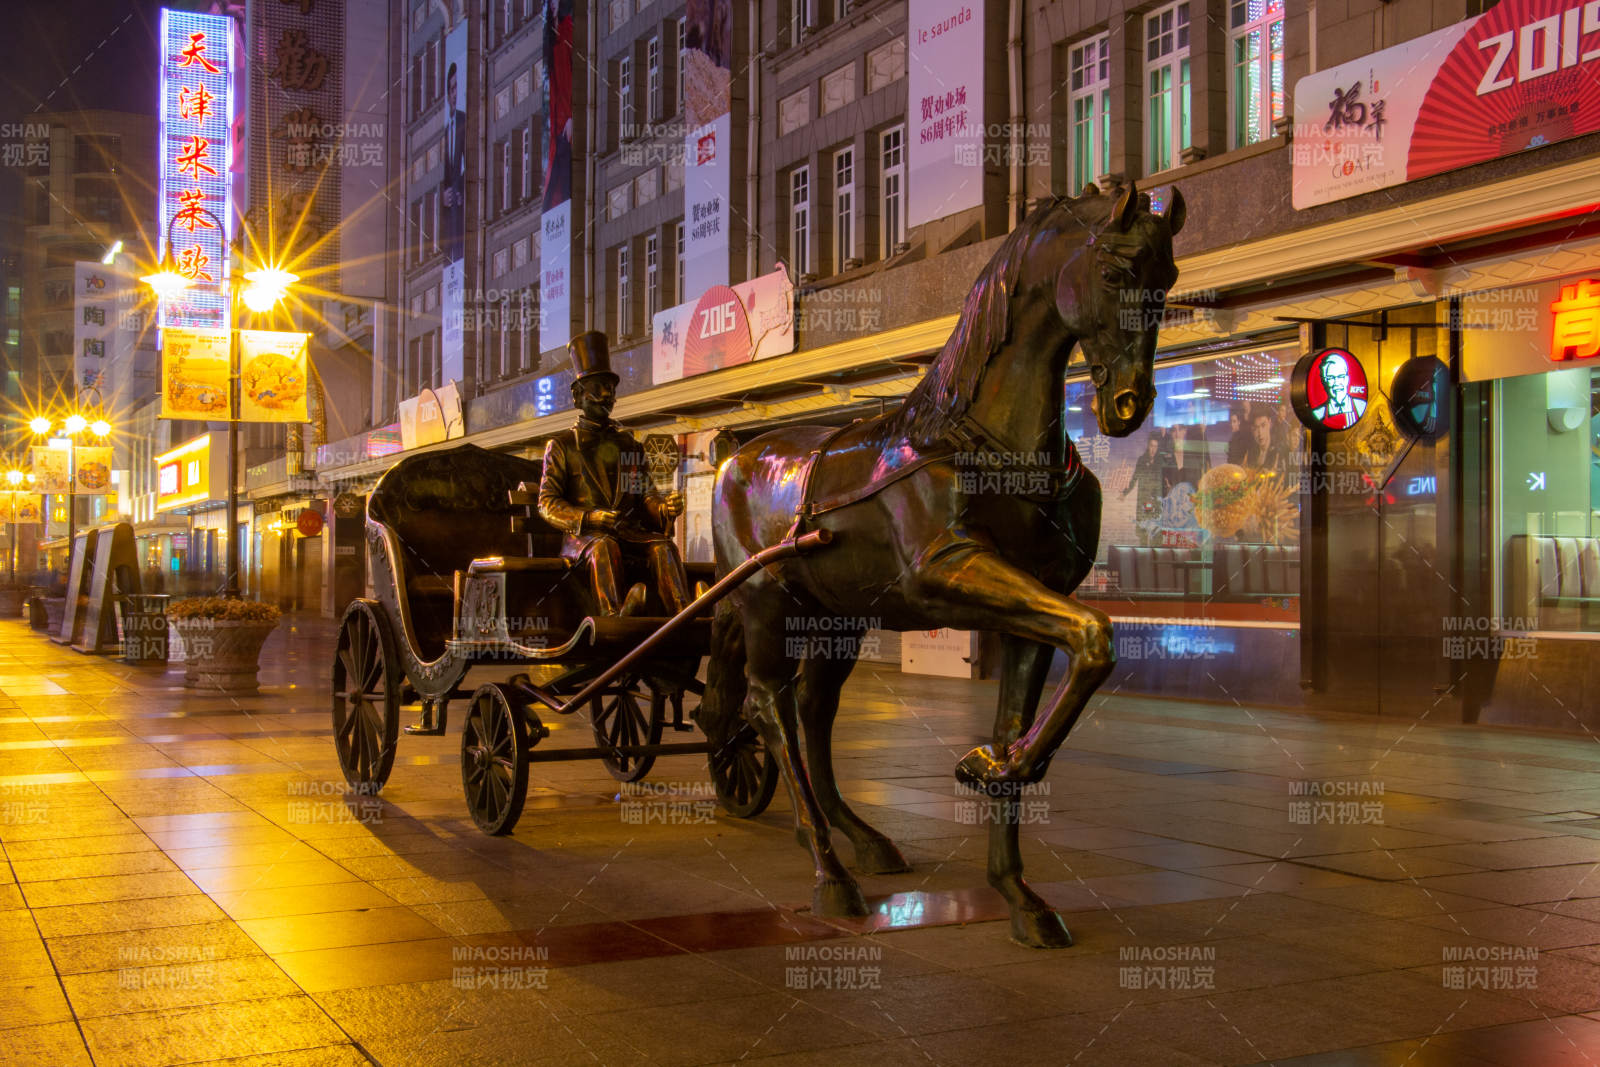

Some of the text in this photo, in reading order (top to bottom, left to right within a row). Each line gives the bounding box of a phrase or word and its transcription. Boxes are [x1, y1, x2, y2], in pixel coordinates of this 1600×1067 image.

[918, 7, 972, 45] le saunda
[921, 86, 967, 125] 贺劝业场
[920, 110, 968, 145] 86周年庆
[700, 301, 737, 340] 2015
[1350, 385, 1366, 395] KFC
